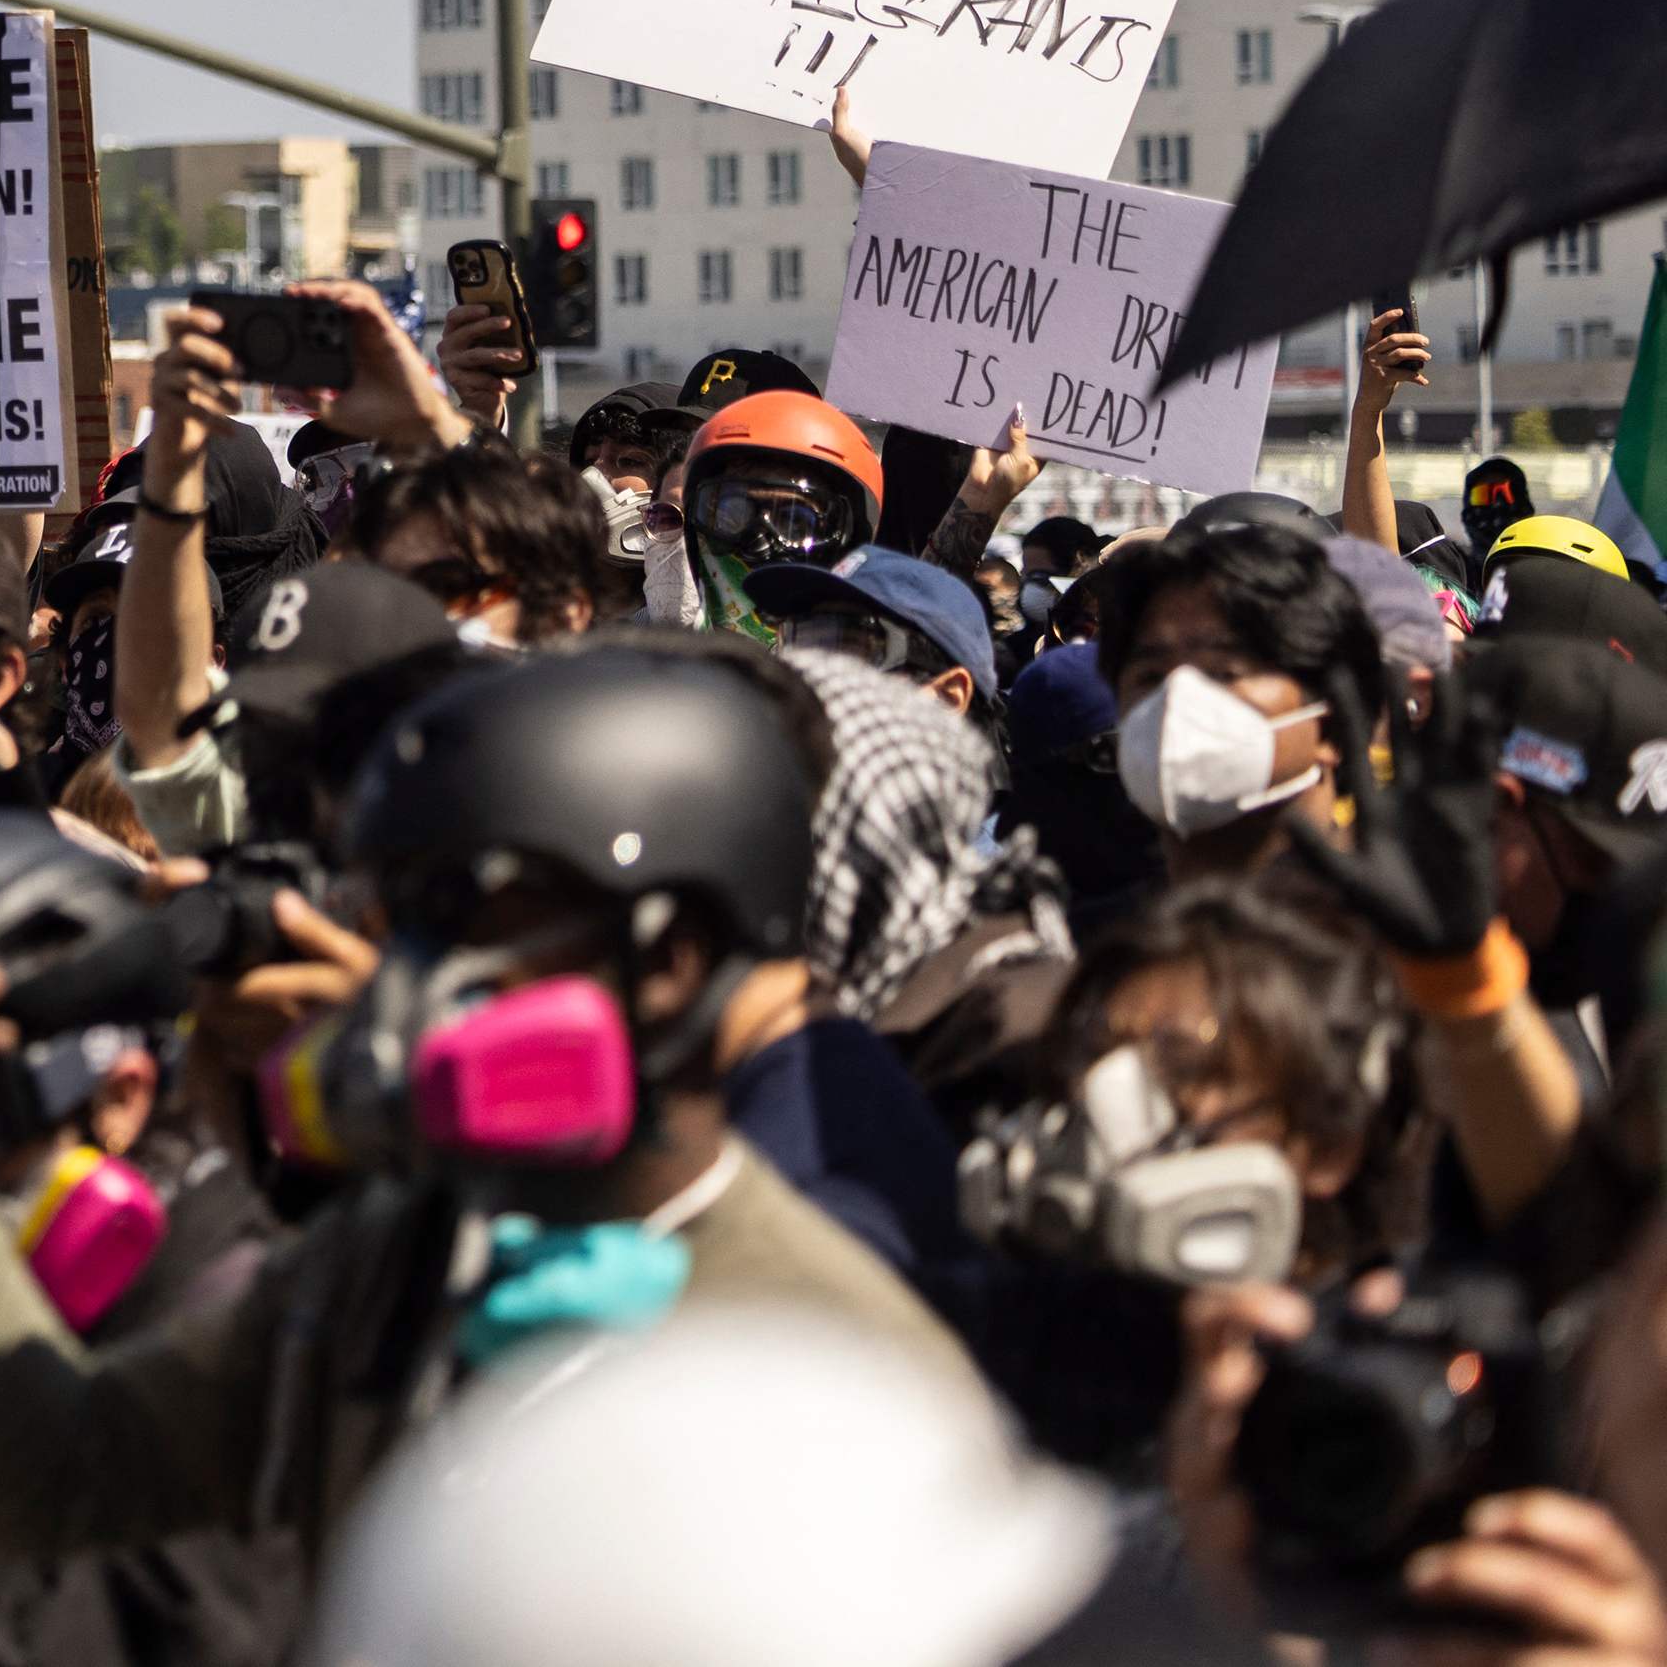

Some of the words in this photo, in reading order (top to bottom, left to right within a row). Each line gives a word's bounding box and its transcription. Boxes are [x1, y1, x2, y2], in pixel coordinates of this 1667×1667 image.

[1030, 182, 1147, 274] THE
[854, 235, 1058, 344] AMERICAN
[945, 348, 1000, 409] IS
[1042, 371, 1167, 457] DEAD!
